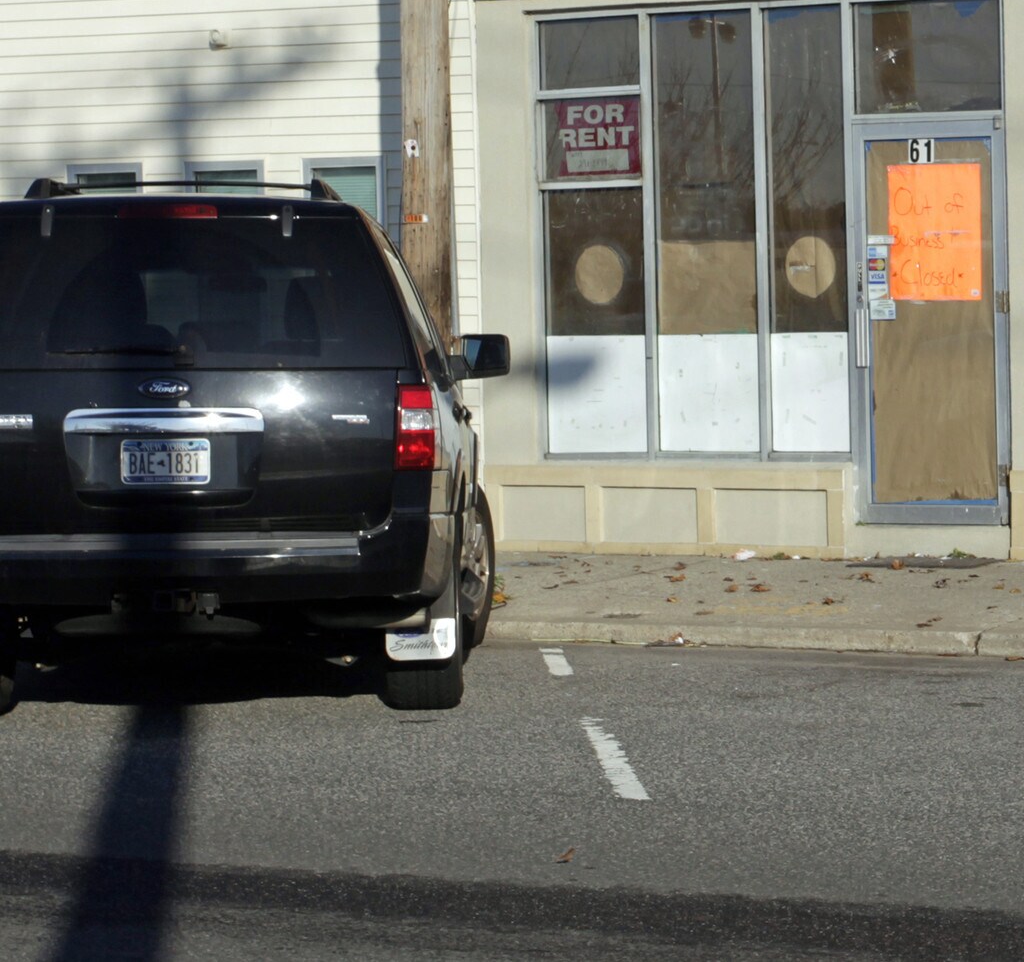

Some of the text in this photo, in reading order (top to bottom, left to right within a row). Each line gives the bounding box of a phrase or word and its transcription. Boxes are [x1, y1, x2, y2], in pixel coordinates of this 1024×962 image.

[567, 104, 625, 125] FOR
[559, 126, 634, 148] RENT
[910, 139, 932, 162] 61
[894, 187, 964, 215] Out of
[149, 382, 178, 393] Ford
